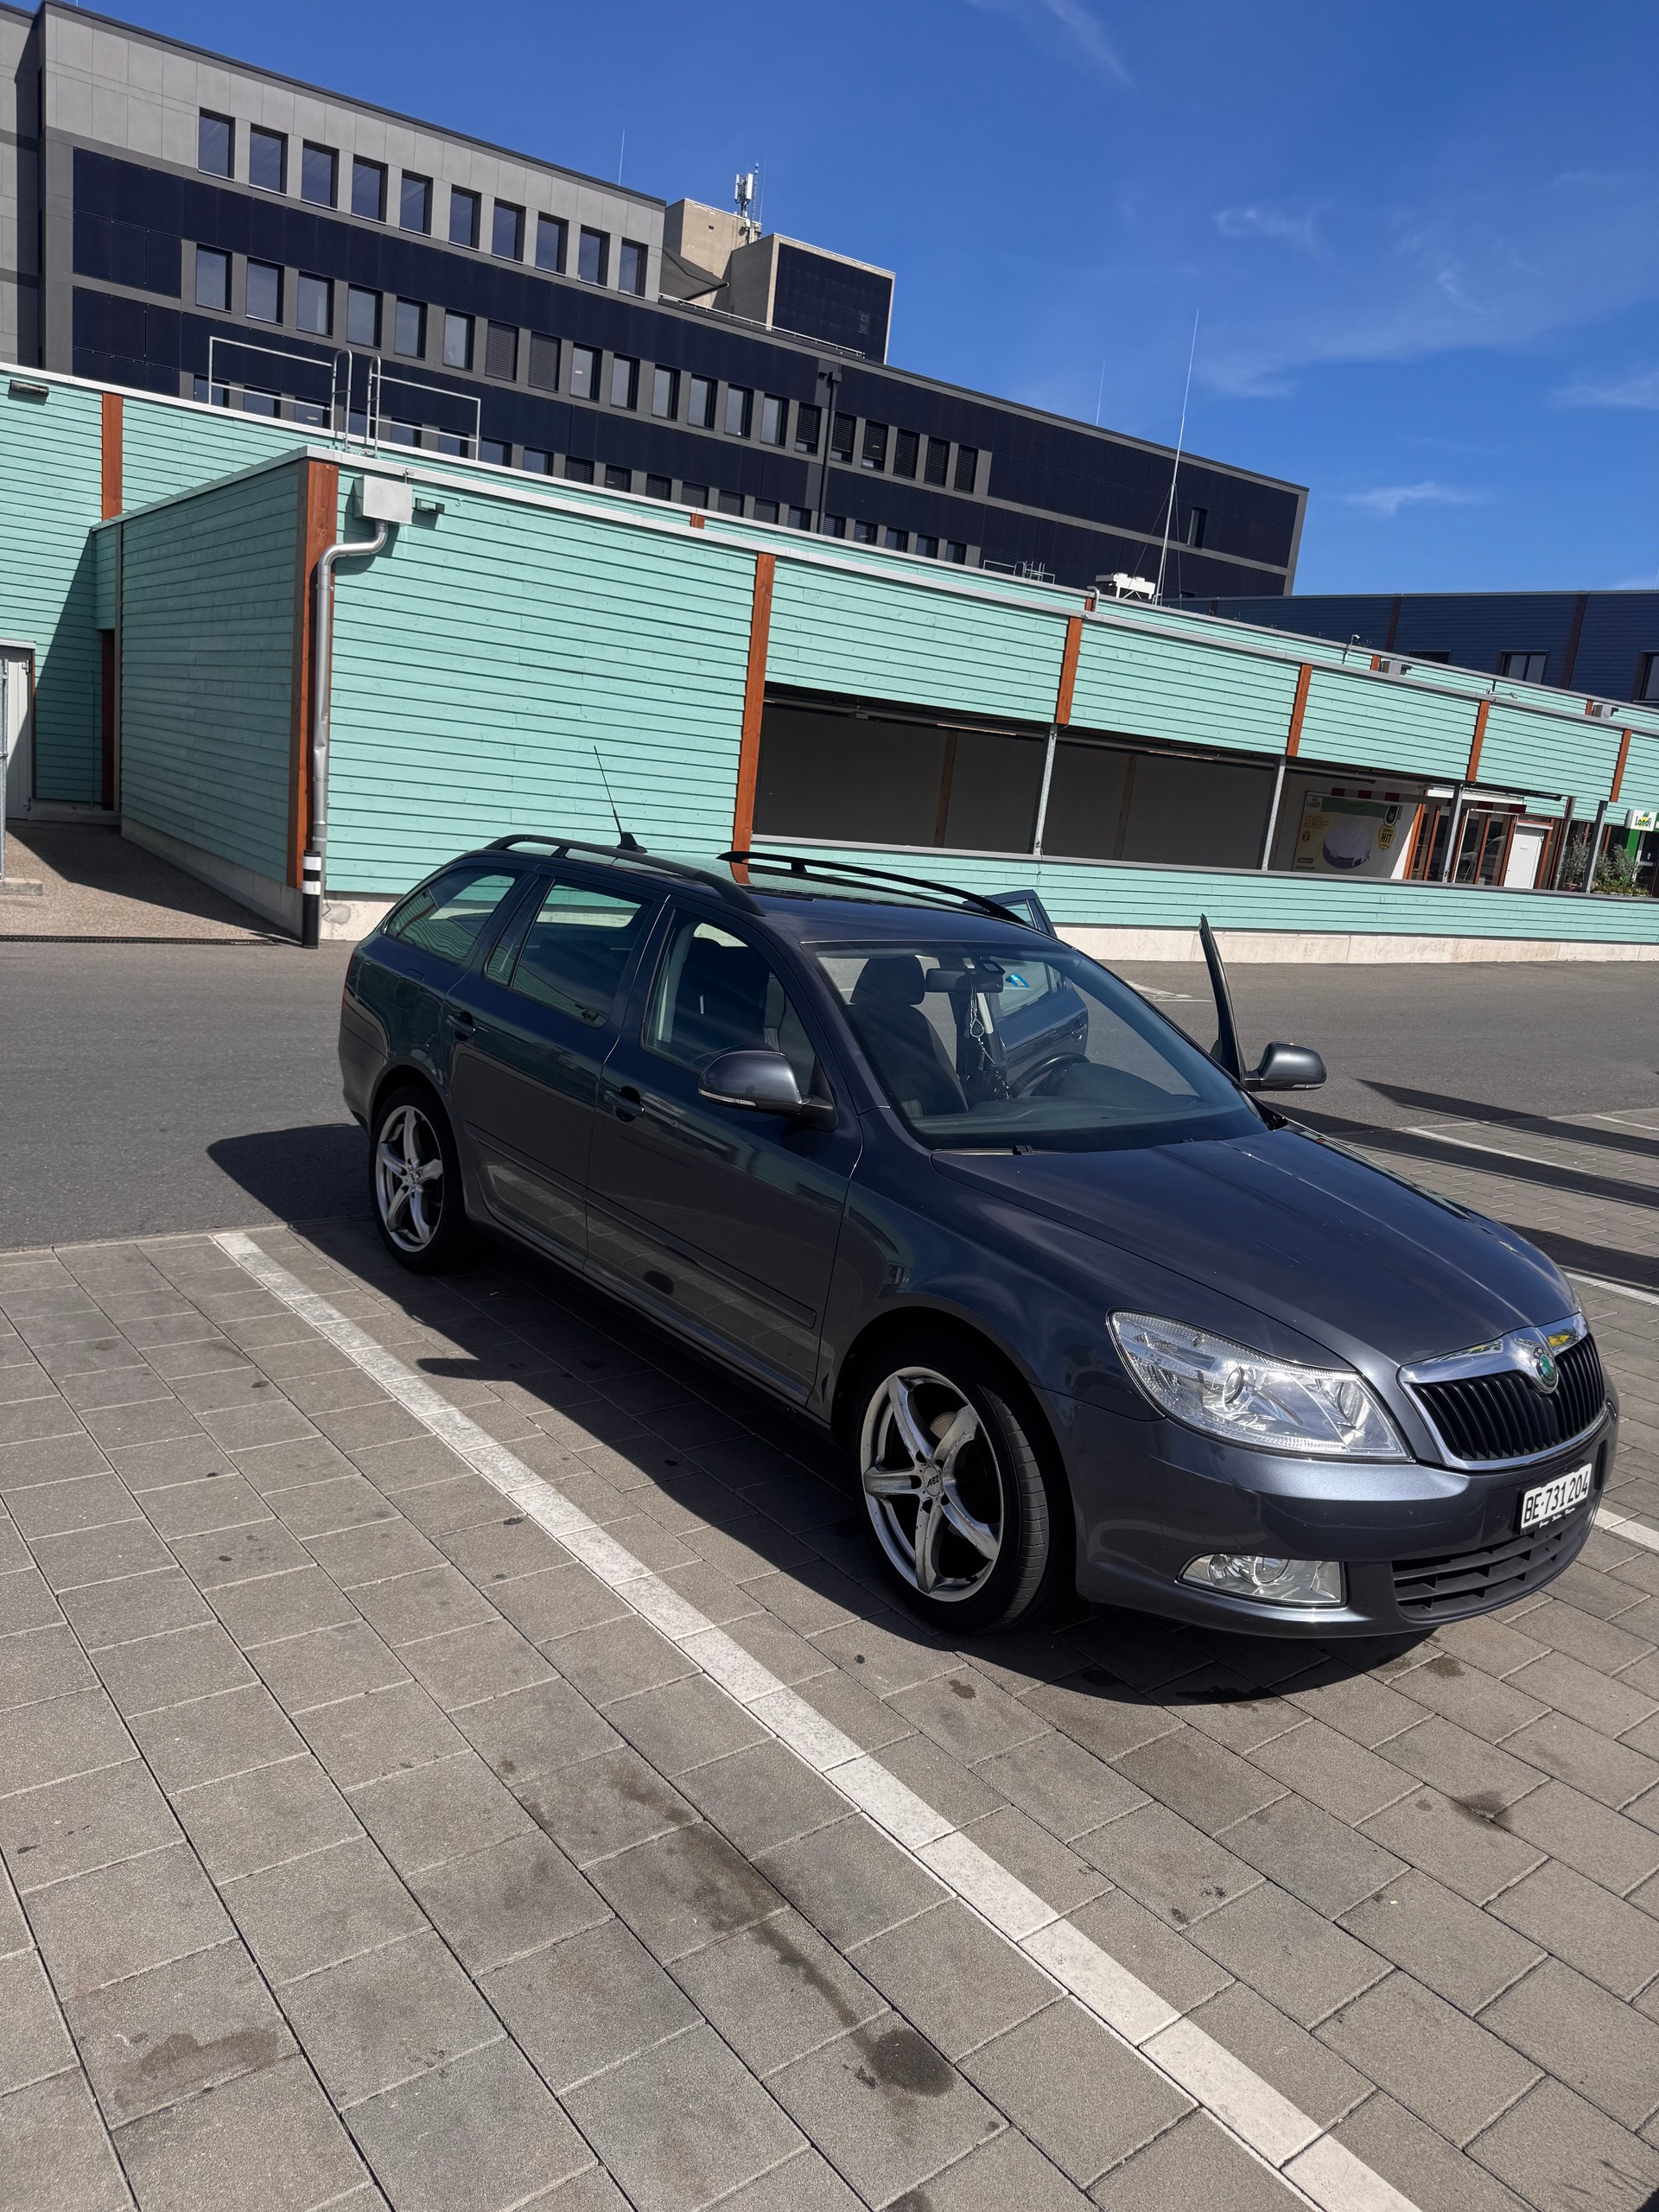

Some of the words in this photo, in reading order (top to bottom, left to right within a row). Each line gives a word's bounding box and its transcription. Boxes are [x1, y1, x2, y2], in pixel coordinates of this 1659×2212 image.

[1635, 817, 1652, 827] Landi
[1381, 832, 1392, 843] HIT
[926, 1475, 939, 1487] AEZ
